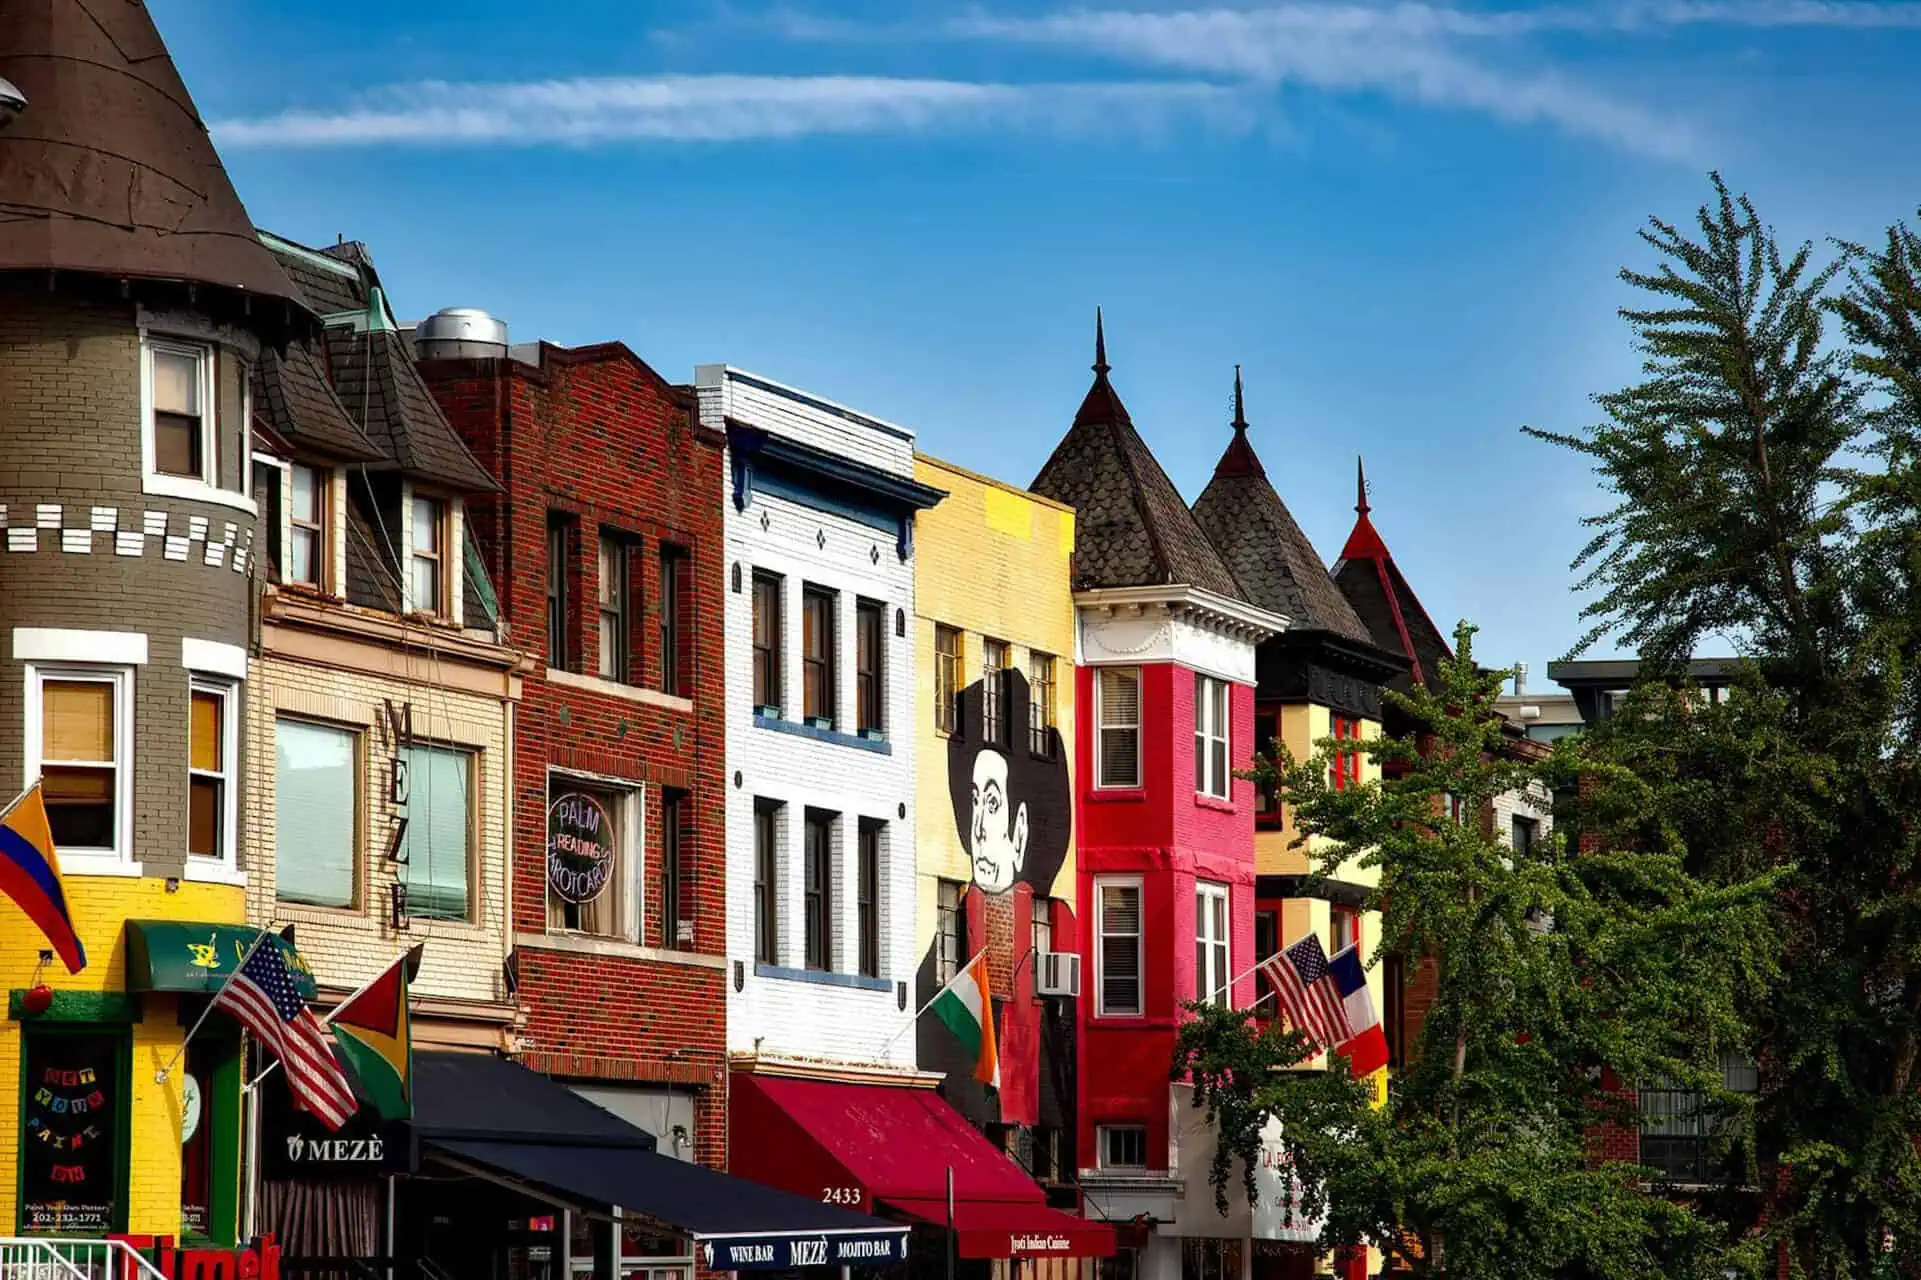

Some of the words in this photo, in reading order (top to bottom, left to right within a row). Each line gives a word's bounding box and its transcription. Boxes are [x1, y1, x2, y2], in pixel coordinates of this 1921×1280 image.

[559, 800, 600, 834] PALM
[556, 833, 600, 860] READING
[27, 1117, 101, 1152] PAINT
[308, 1134, 384, 1161] MEZÈ
[823, 1188, 861, 1205] 2433
[729, 1246, 754, 1263] WINE
[755, 1244, 775, 1262] BAR
[789, 1234, 828, 1266] MEZÈ
[837, 1241, 873, 1258] MOJITO
[873, 1239, 892, 1256] BAR
[1026, 1234, 1047, 1250] Indian
[1047, 1234, 1072, 1250] Cuisine
